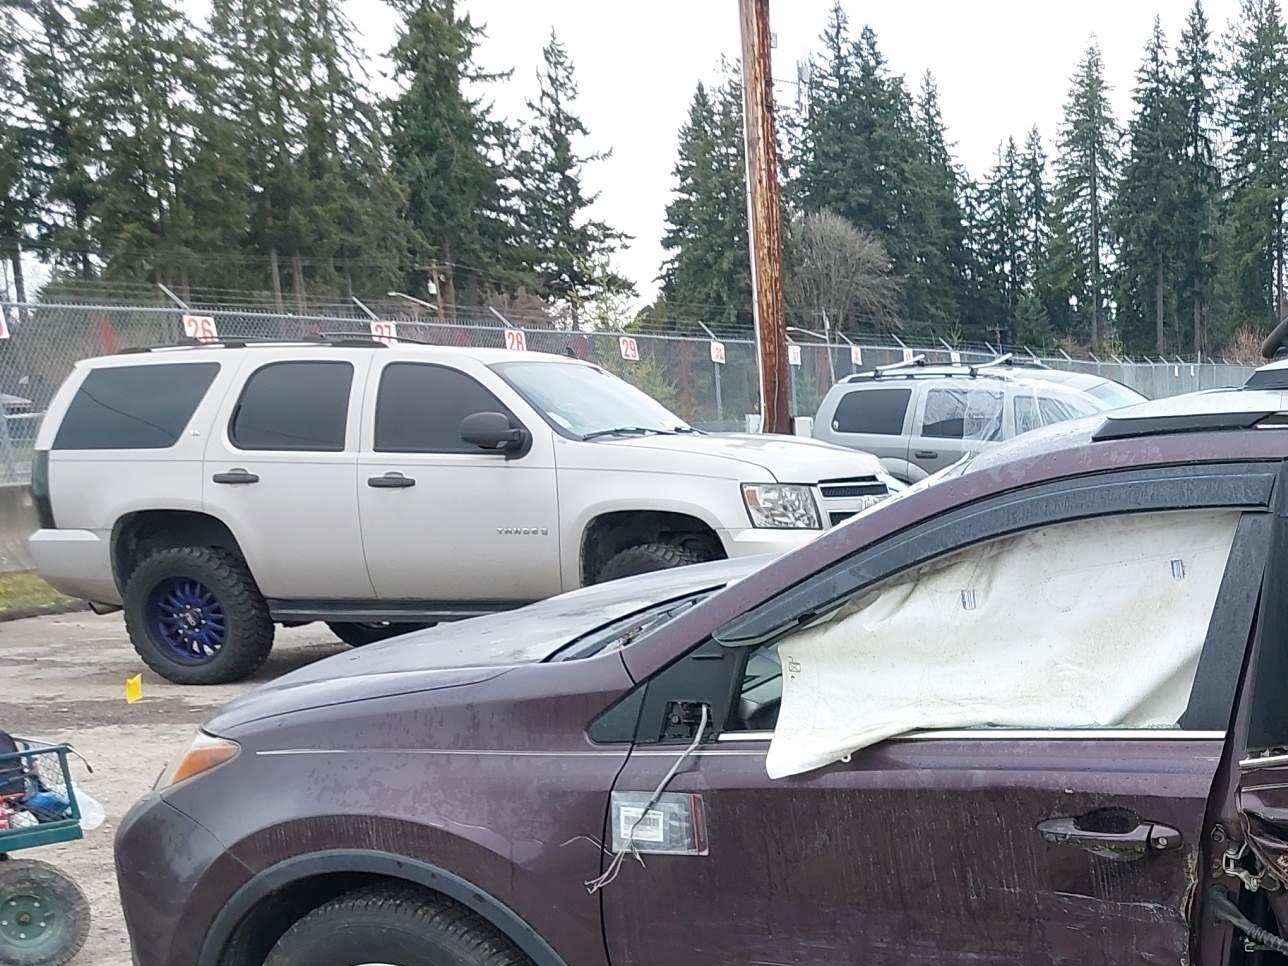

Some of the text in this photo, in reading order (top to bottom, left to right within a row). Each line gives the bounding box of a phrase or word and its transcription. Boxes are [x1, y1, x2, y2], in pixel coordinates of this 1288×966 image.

[187, 318, 214, 342] 26
[507, 331, 525, 351] 28
[621, 338, 637, 358] 29
